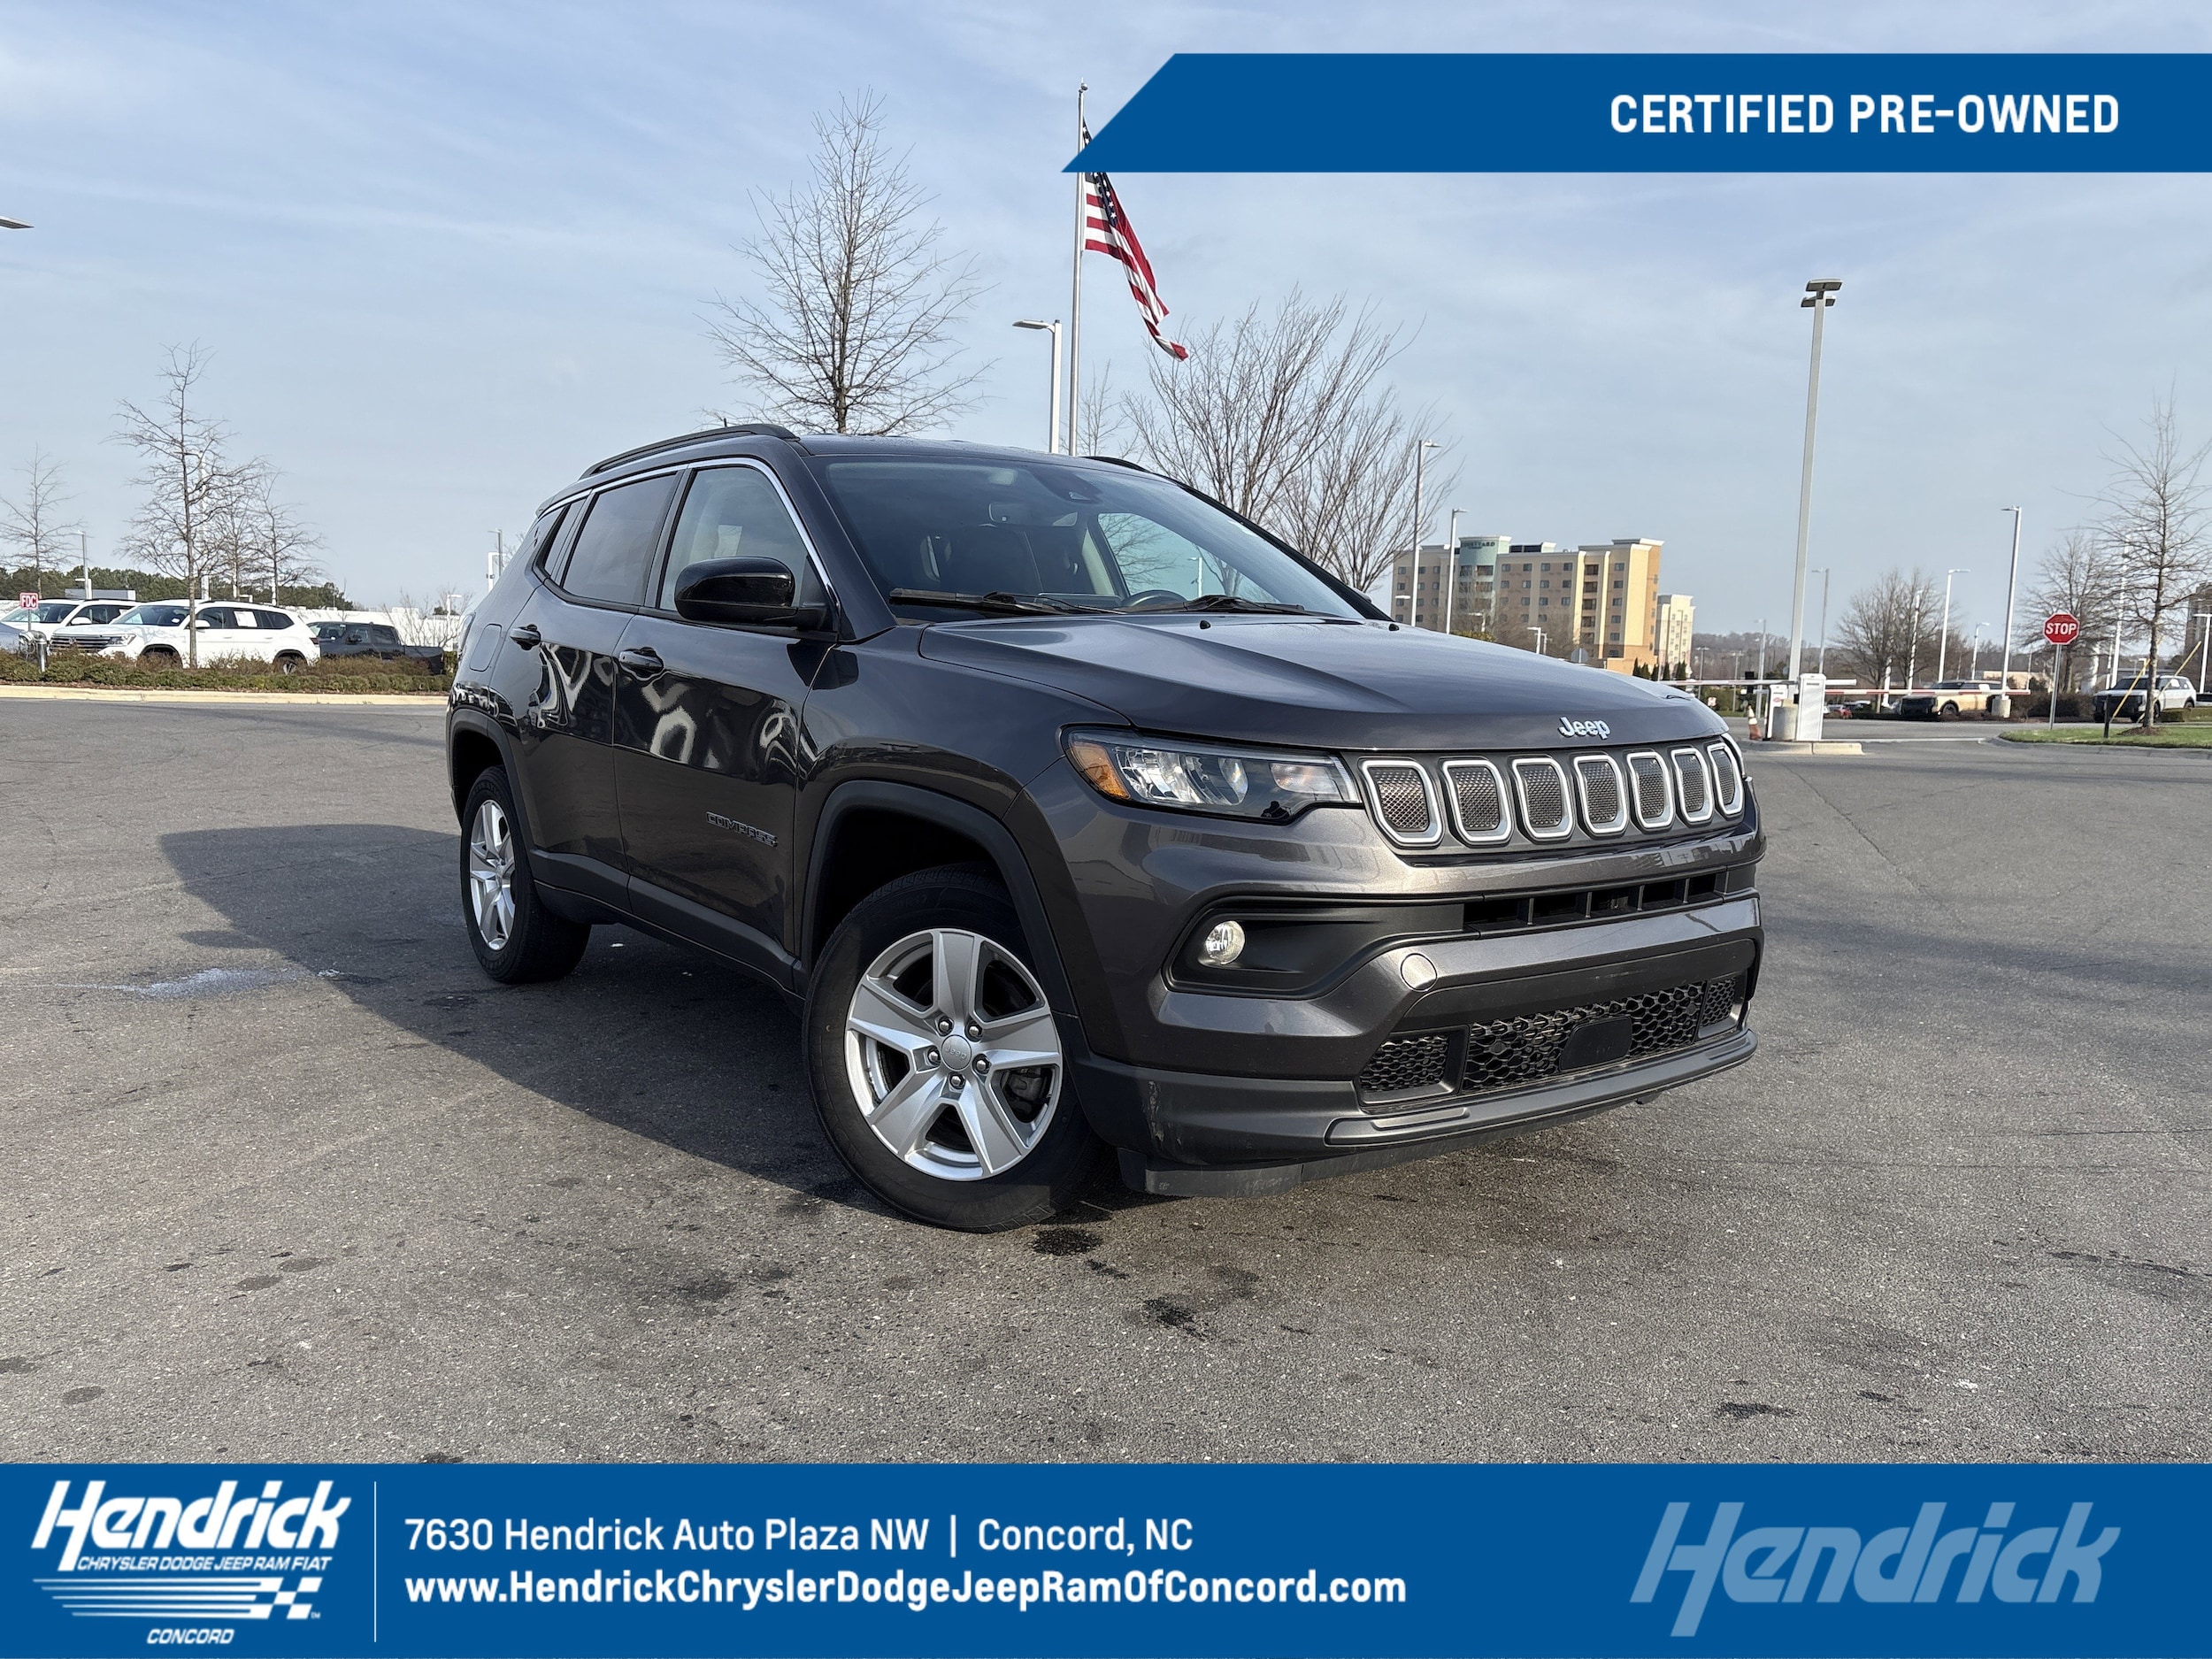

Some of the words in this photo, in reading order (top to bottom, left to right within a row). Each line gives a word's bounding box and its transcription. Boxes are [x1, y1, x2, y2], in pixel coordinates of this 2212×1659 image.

[21, 595, 36, 608] FDC
[2046, 622, 2077, 635] STOP
[1558, 717, 1610, 740] Jeep
[706, 811, 779, 848] COMPASS
